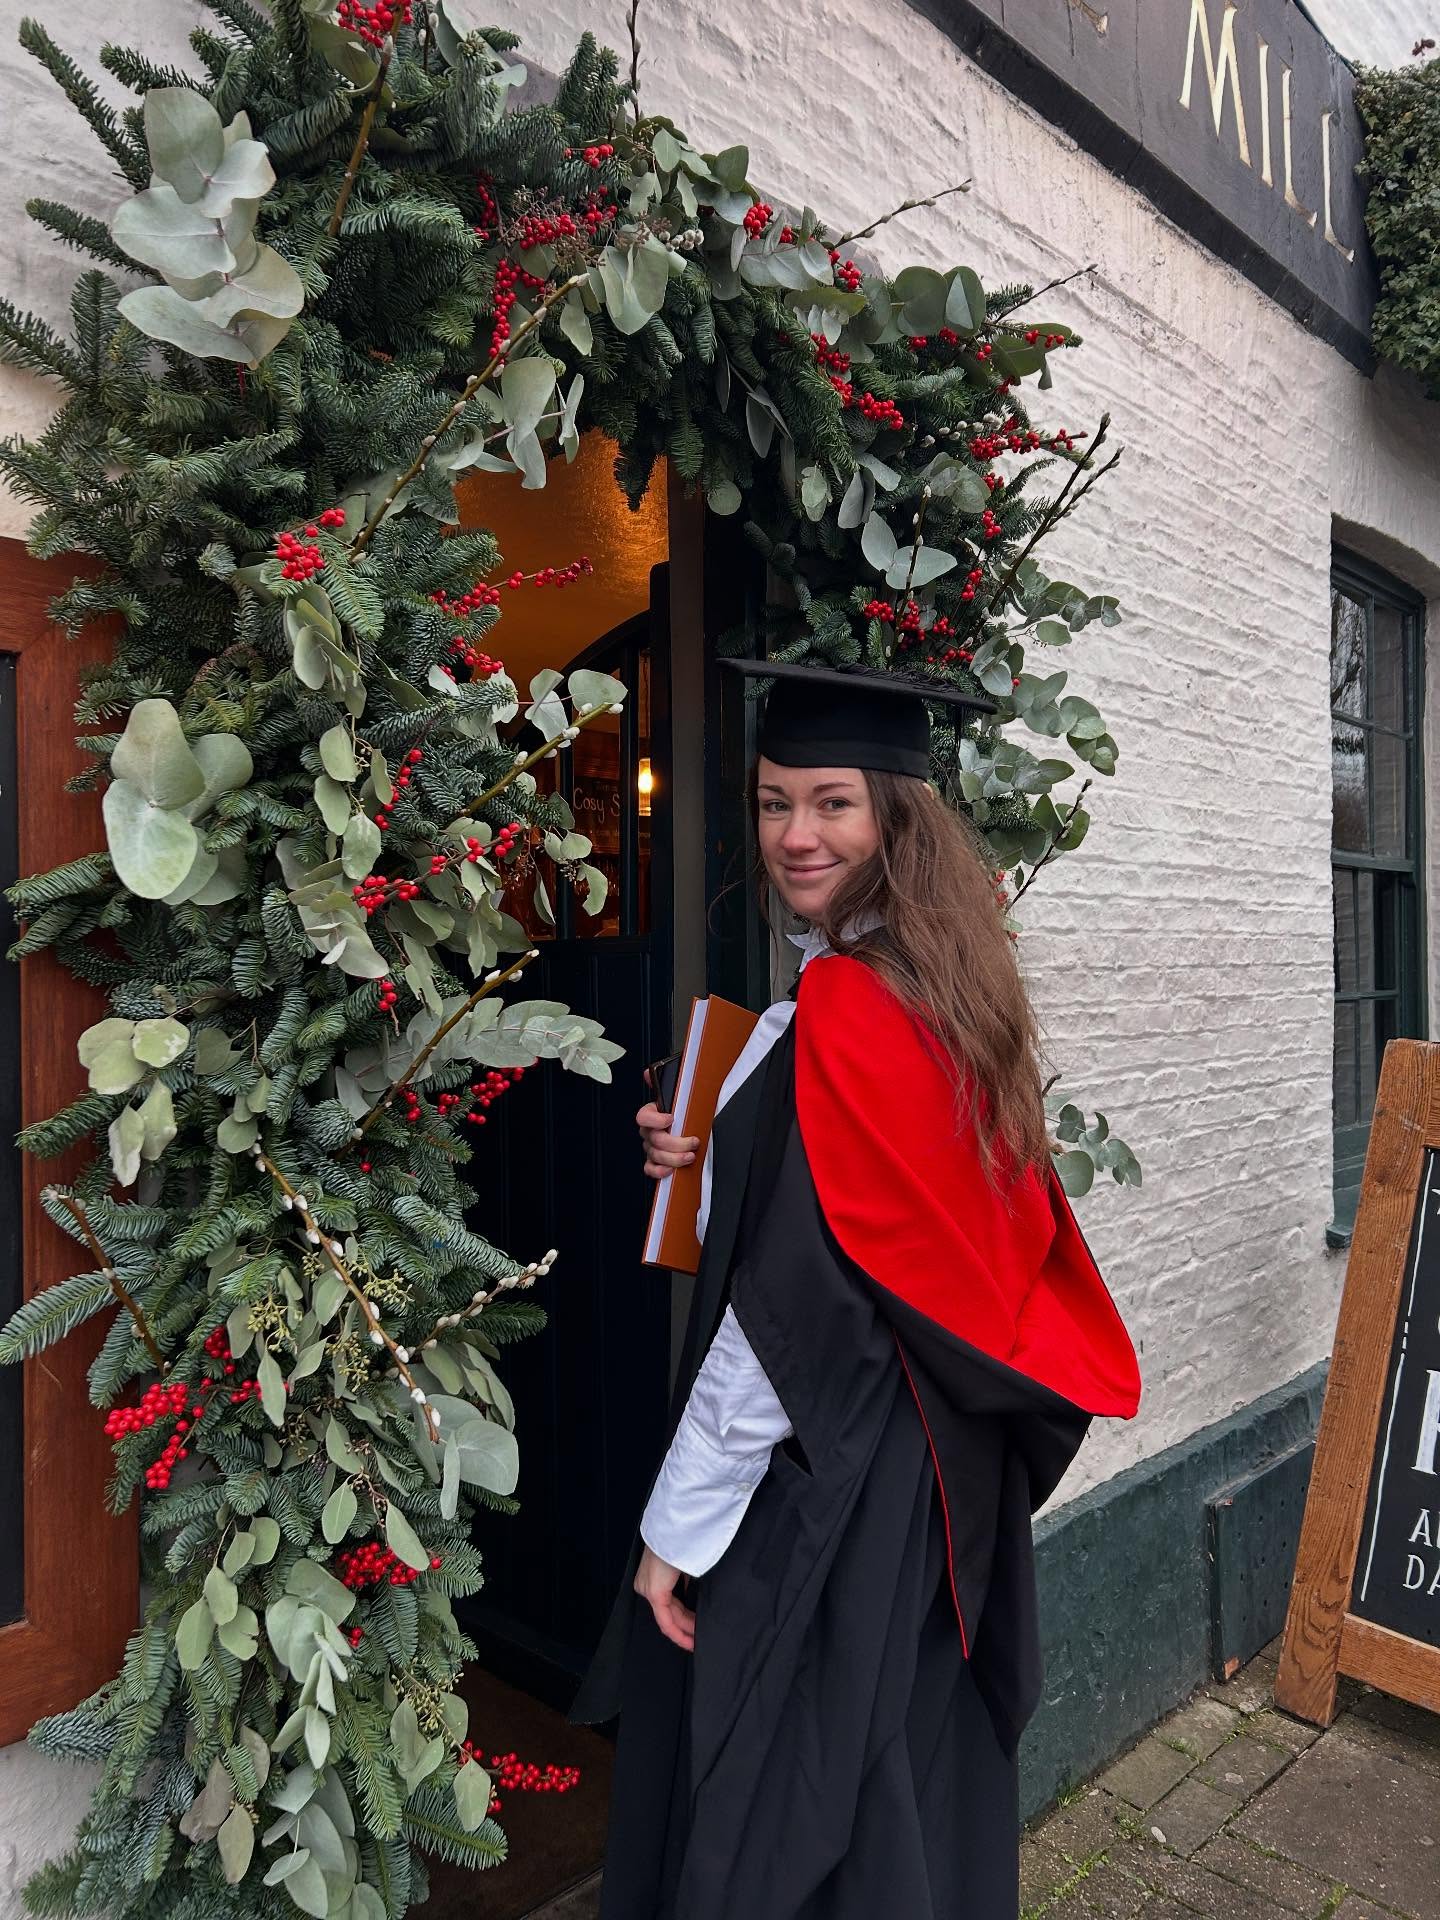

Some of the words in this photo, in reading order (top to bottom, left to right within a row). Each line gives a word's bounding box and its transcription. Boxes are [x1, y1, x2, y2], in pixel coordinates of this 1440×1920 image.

[1178, 0, 1355, 264] MILL
[574, 788, 605, 824] Cosy
[1408, 1508, 1440, 1549] A
